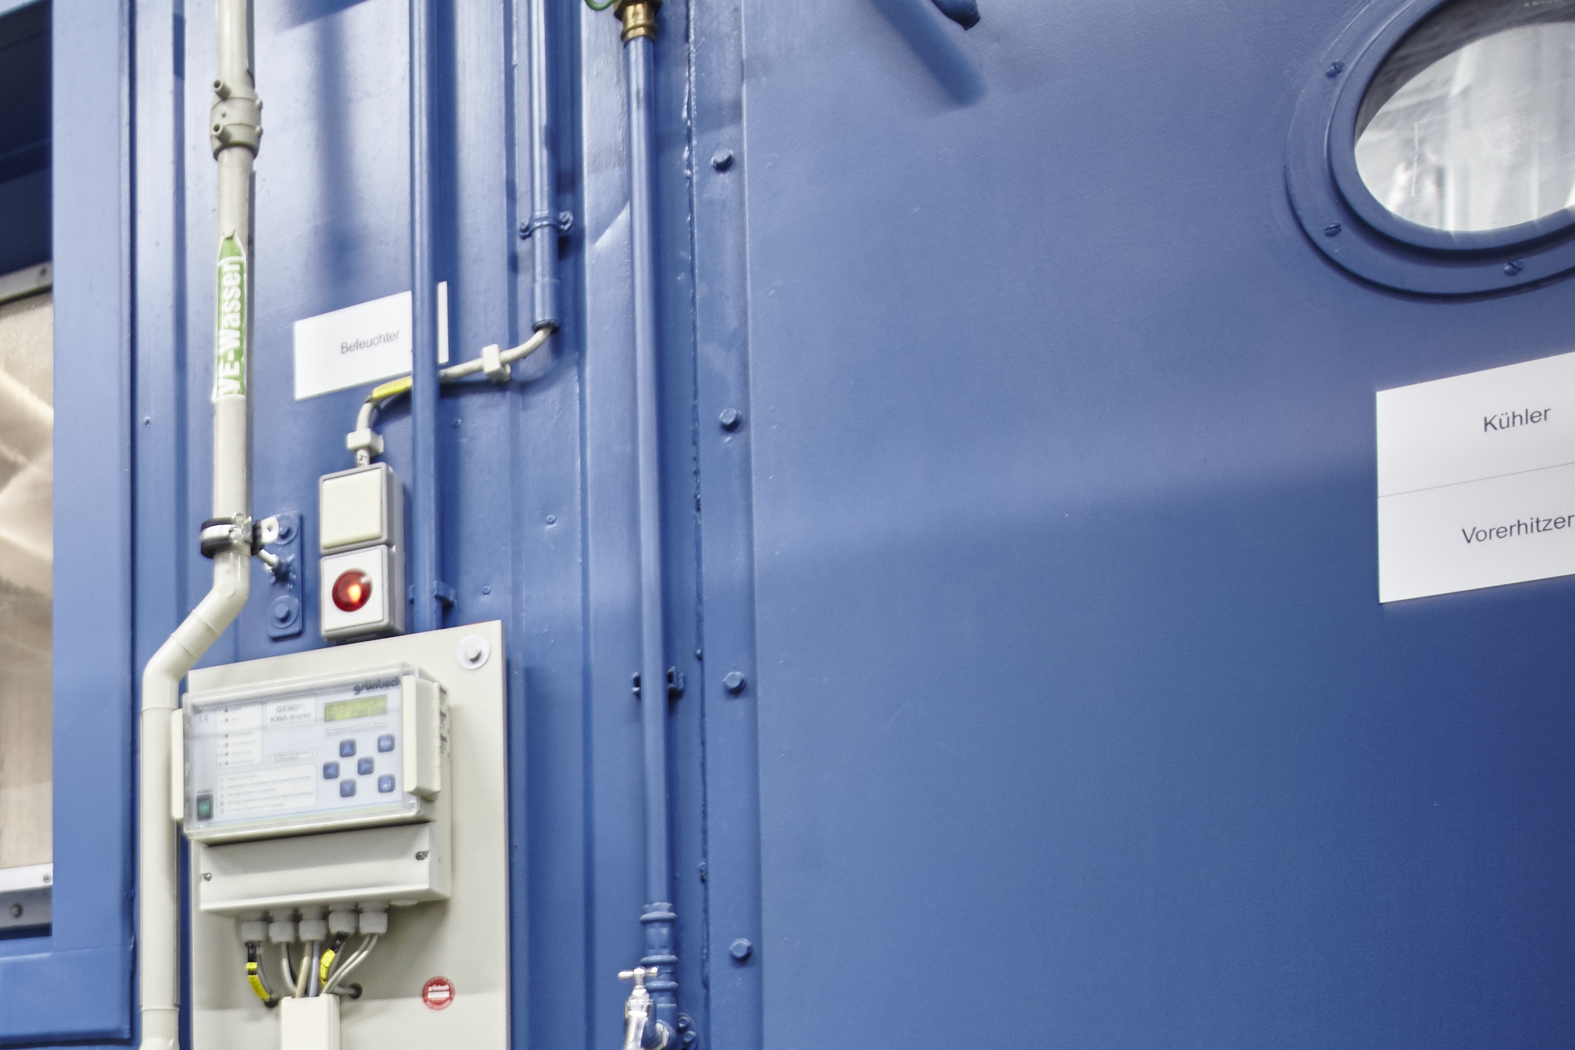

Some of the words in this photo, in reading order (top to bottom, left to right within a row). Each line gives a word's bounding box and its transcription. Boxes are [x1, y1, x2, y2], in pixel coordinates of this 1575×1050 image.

[218, 262, 242, 395] VE-Wasser
[340, 330, 401, 355] Befeuchter
[1483, 407, 1552, 433] Kühler
[1461, 513, 1575, 545] Vorerhitzer
